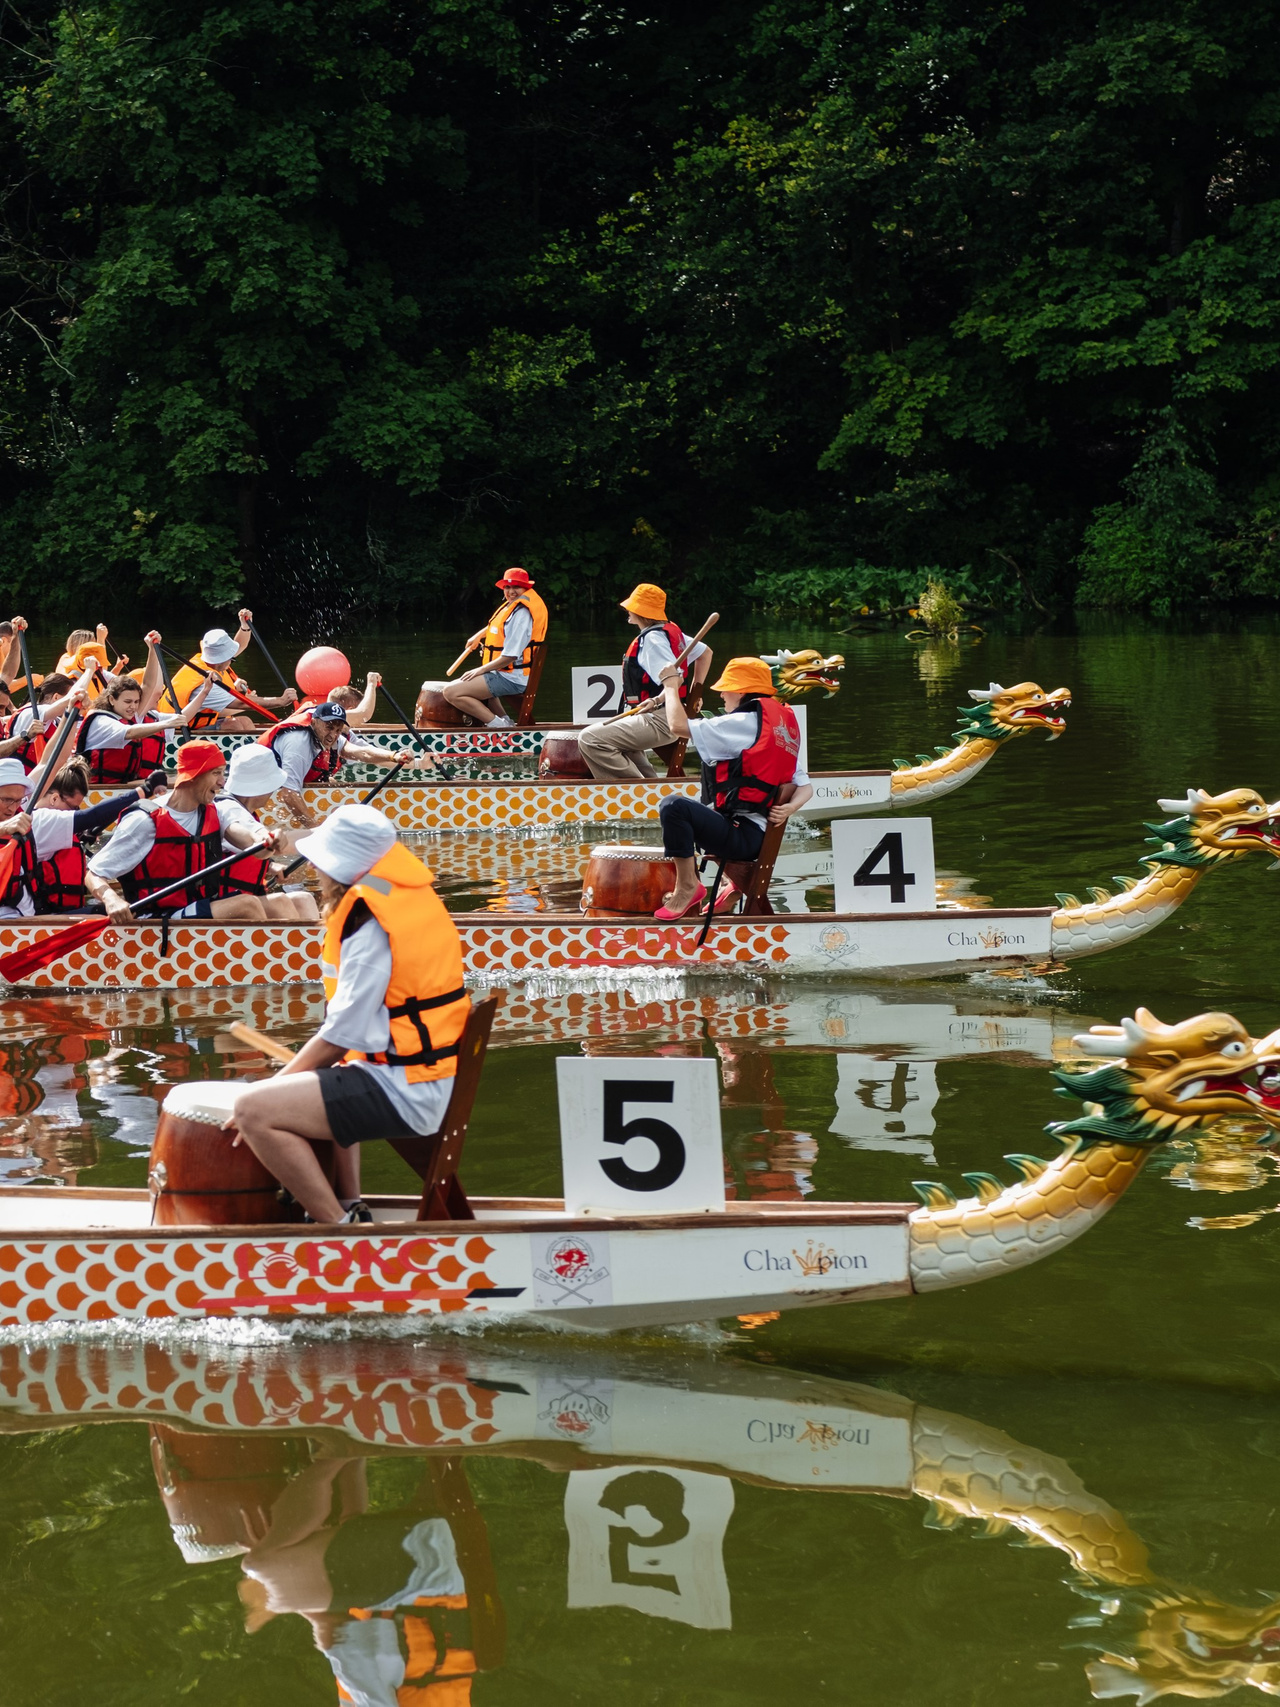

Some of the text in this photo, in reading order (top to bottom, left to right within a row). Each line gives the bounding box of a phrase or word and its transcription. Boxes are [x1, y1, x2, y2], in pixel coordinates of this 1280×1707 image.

[587, 673, 618, 718] 2
[816, 786, 873, 799] Chapion
[853, 832, 916, 903] 4
[947, 930, 1026, 949] Chapion
[598, 1079, 686, 1193] 5
[743, 1248, 868, 1276] Chapion
